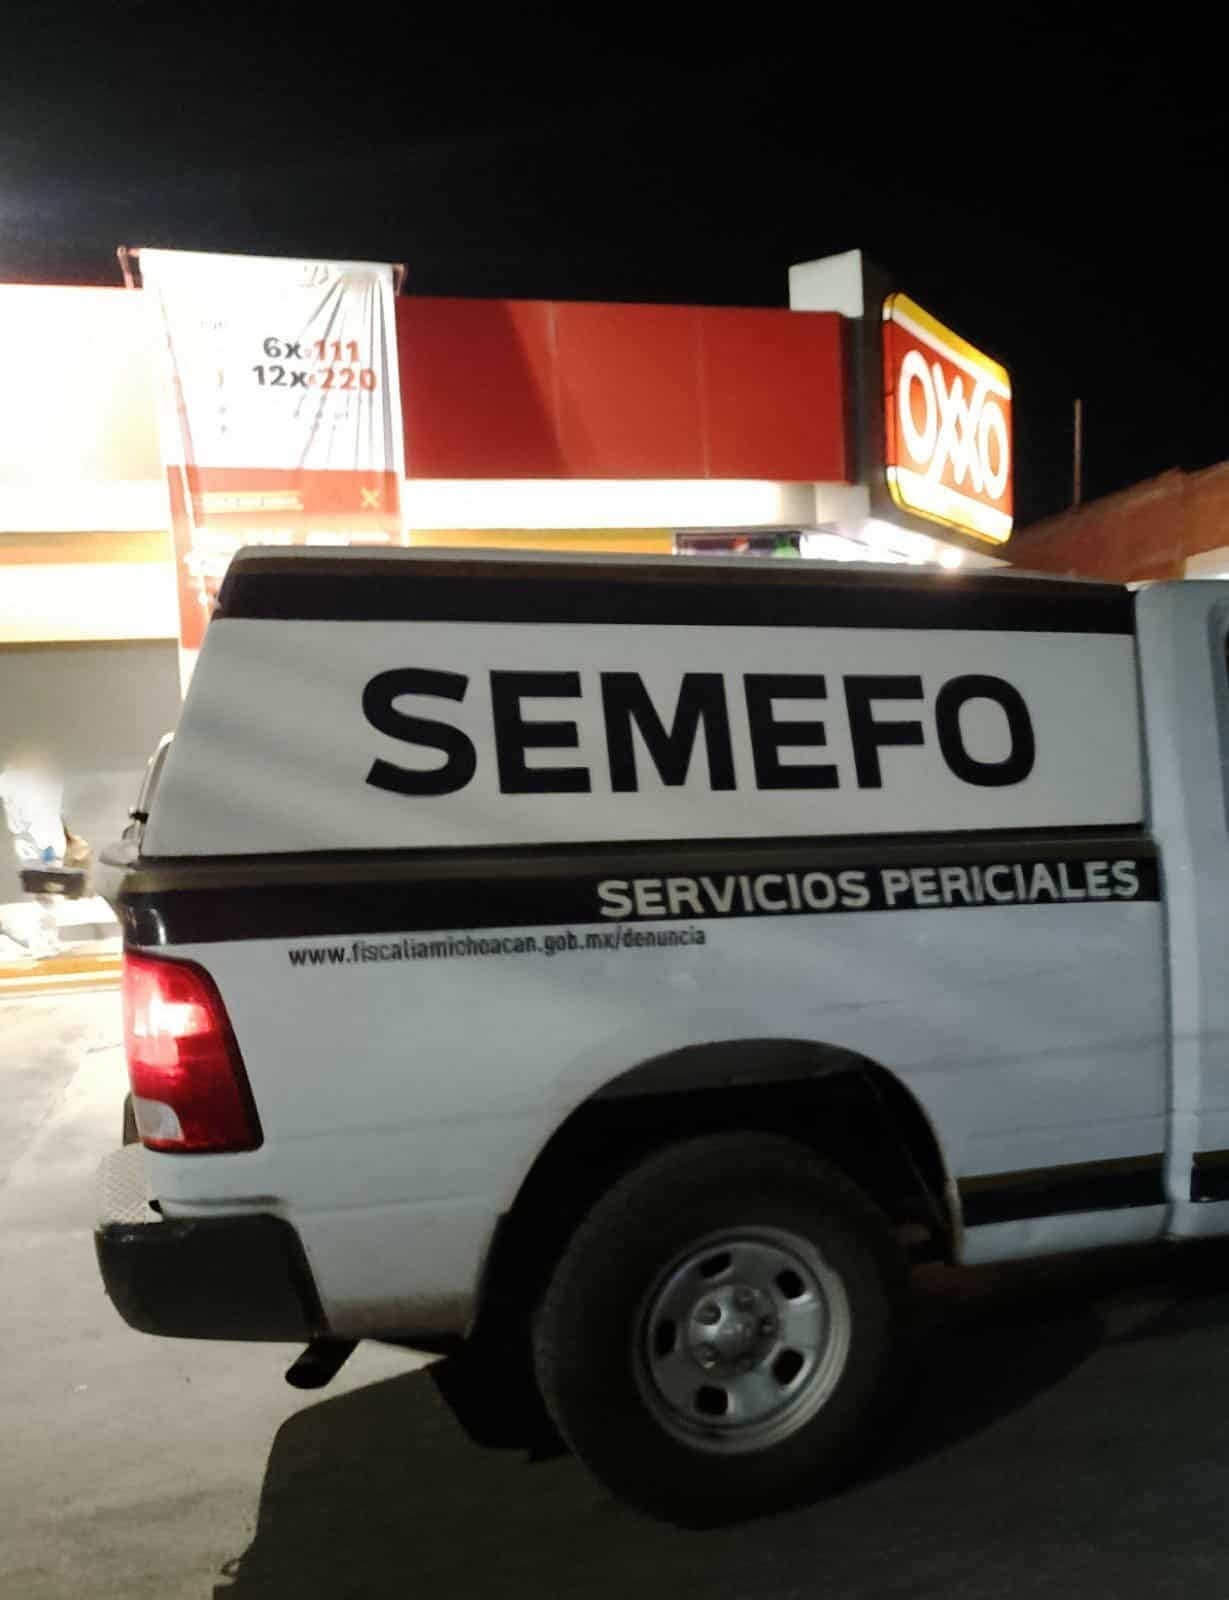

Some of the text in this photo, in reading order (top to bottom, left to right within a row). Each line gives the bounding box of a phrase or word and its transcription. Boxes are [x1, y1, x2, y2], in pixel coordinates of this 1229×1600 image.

[899, 349, 1010, 500] OXXO
[361, 667, 1036, 797] SEMEFO
[597, 859, 1140, 918] SERVICIOS PERICIALES
[288, 925, 707, 967] www.fiscaliamichoacan.gob.mx/denuncia
